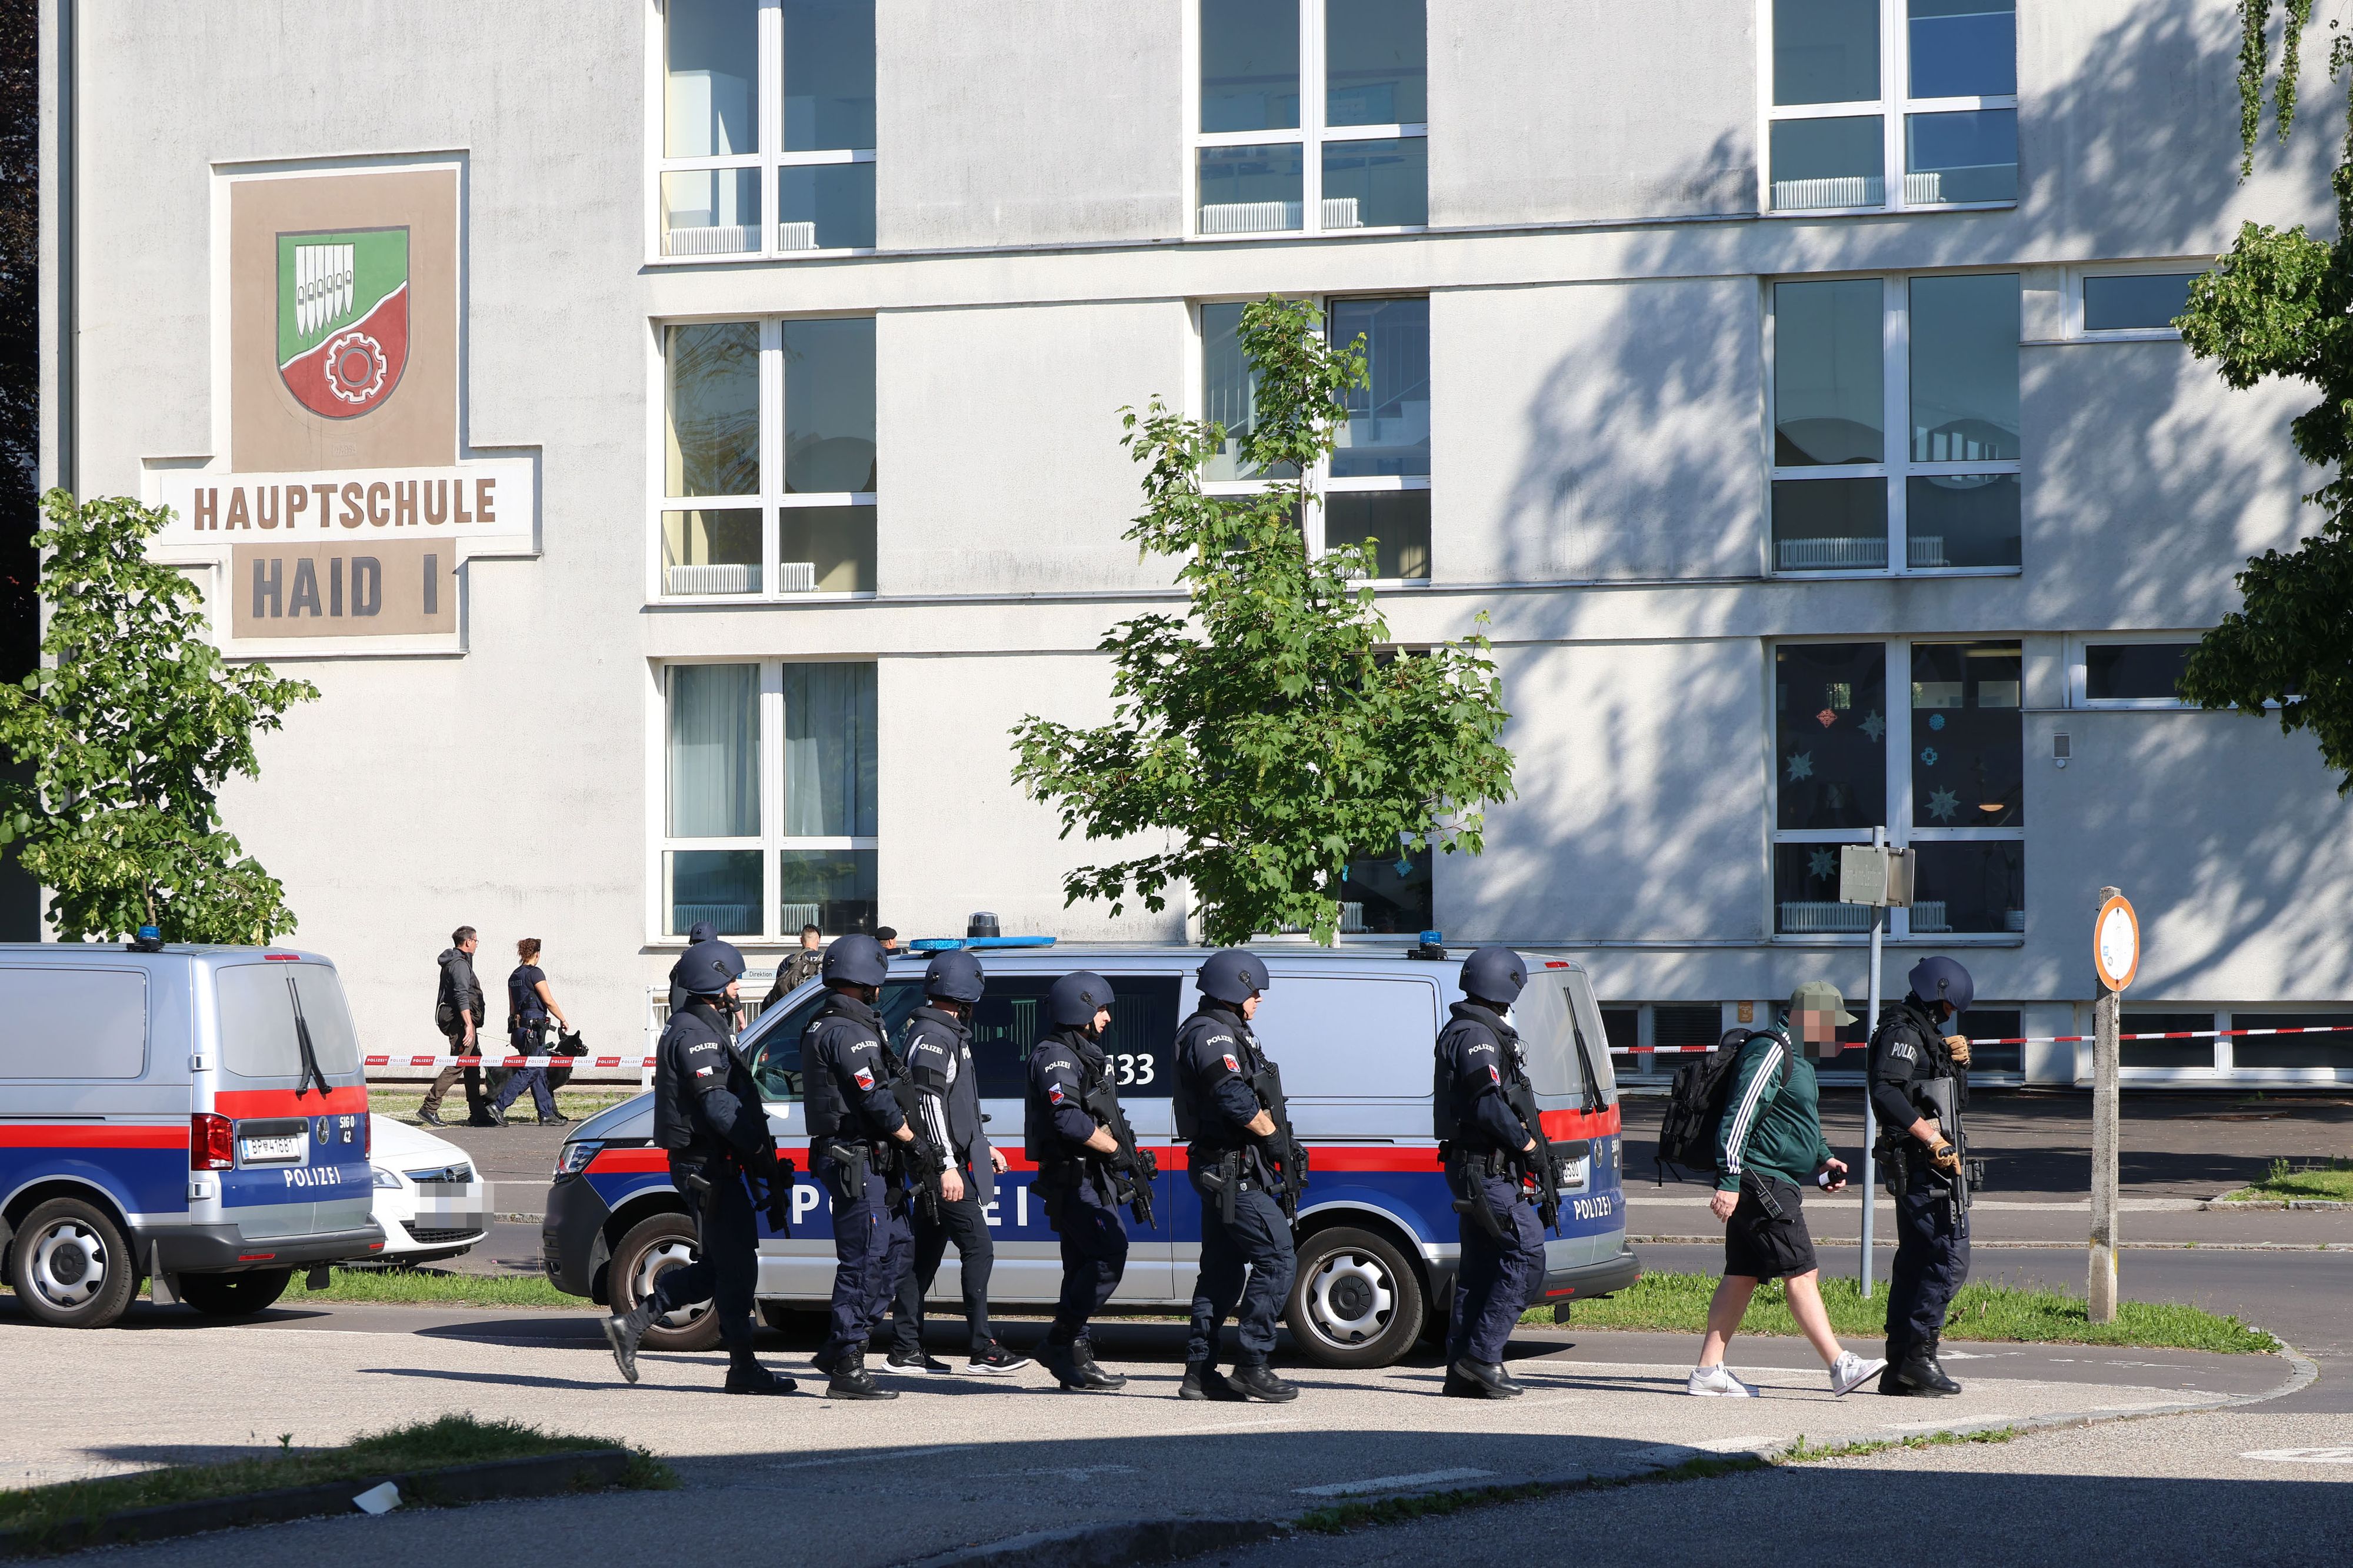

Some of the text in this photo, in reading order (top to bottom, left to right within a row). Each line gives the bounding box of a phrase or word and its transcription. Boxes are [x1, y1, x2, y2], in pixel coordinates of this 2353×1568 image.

[194, 478, 496, 531] HAUPTSCHULE
[252, 554, 438, 618] HAID I
[850, 1040, 879, 1053] POLIZEI
[1206, 1035, 1234, 1046] POLIZEI
[689, 1042, 718, 1055] POLIZEI
[918, 1043, 944, 1055] OLIZEI
[1468, 1043, 1495, 1055] POLIZEI
[1045, 1060, 1071, 1073] POLIZEI
[344, 1130, 352, 1143] 42
[252, 1139, 294, 1154] BP 41681
[283, 1166, 341, 1187] POLIZEI
[1573, 1195, 1611, 1220] POLIZEI
